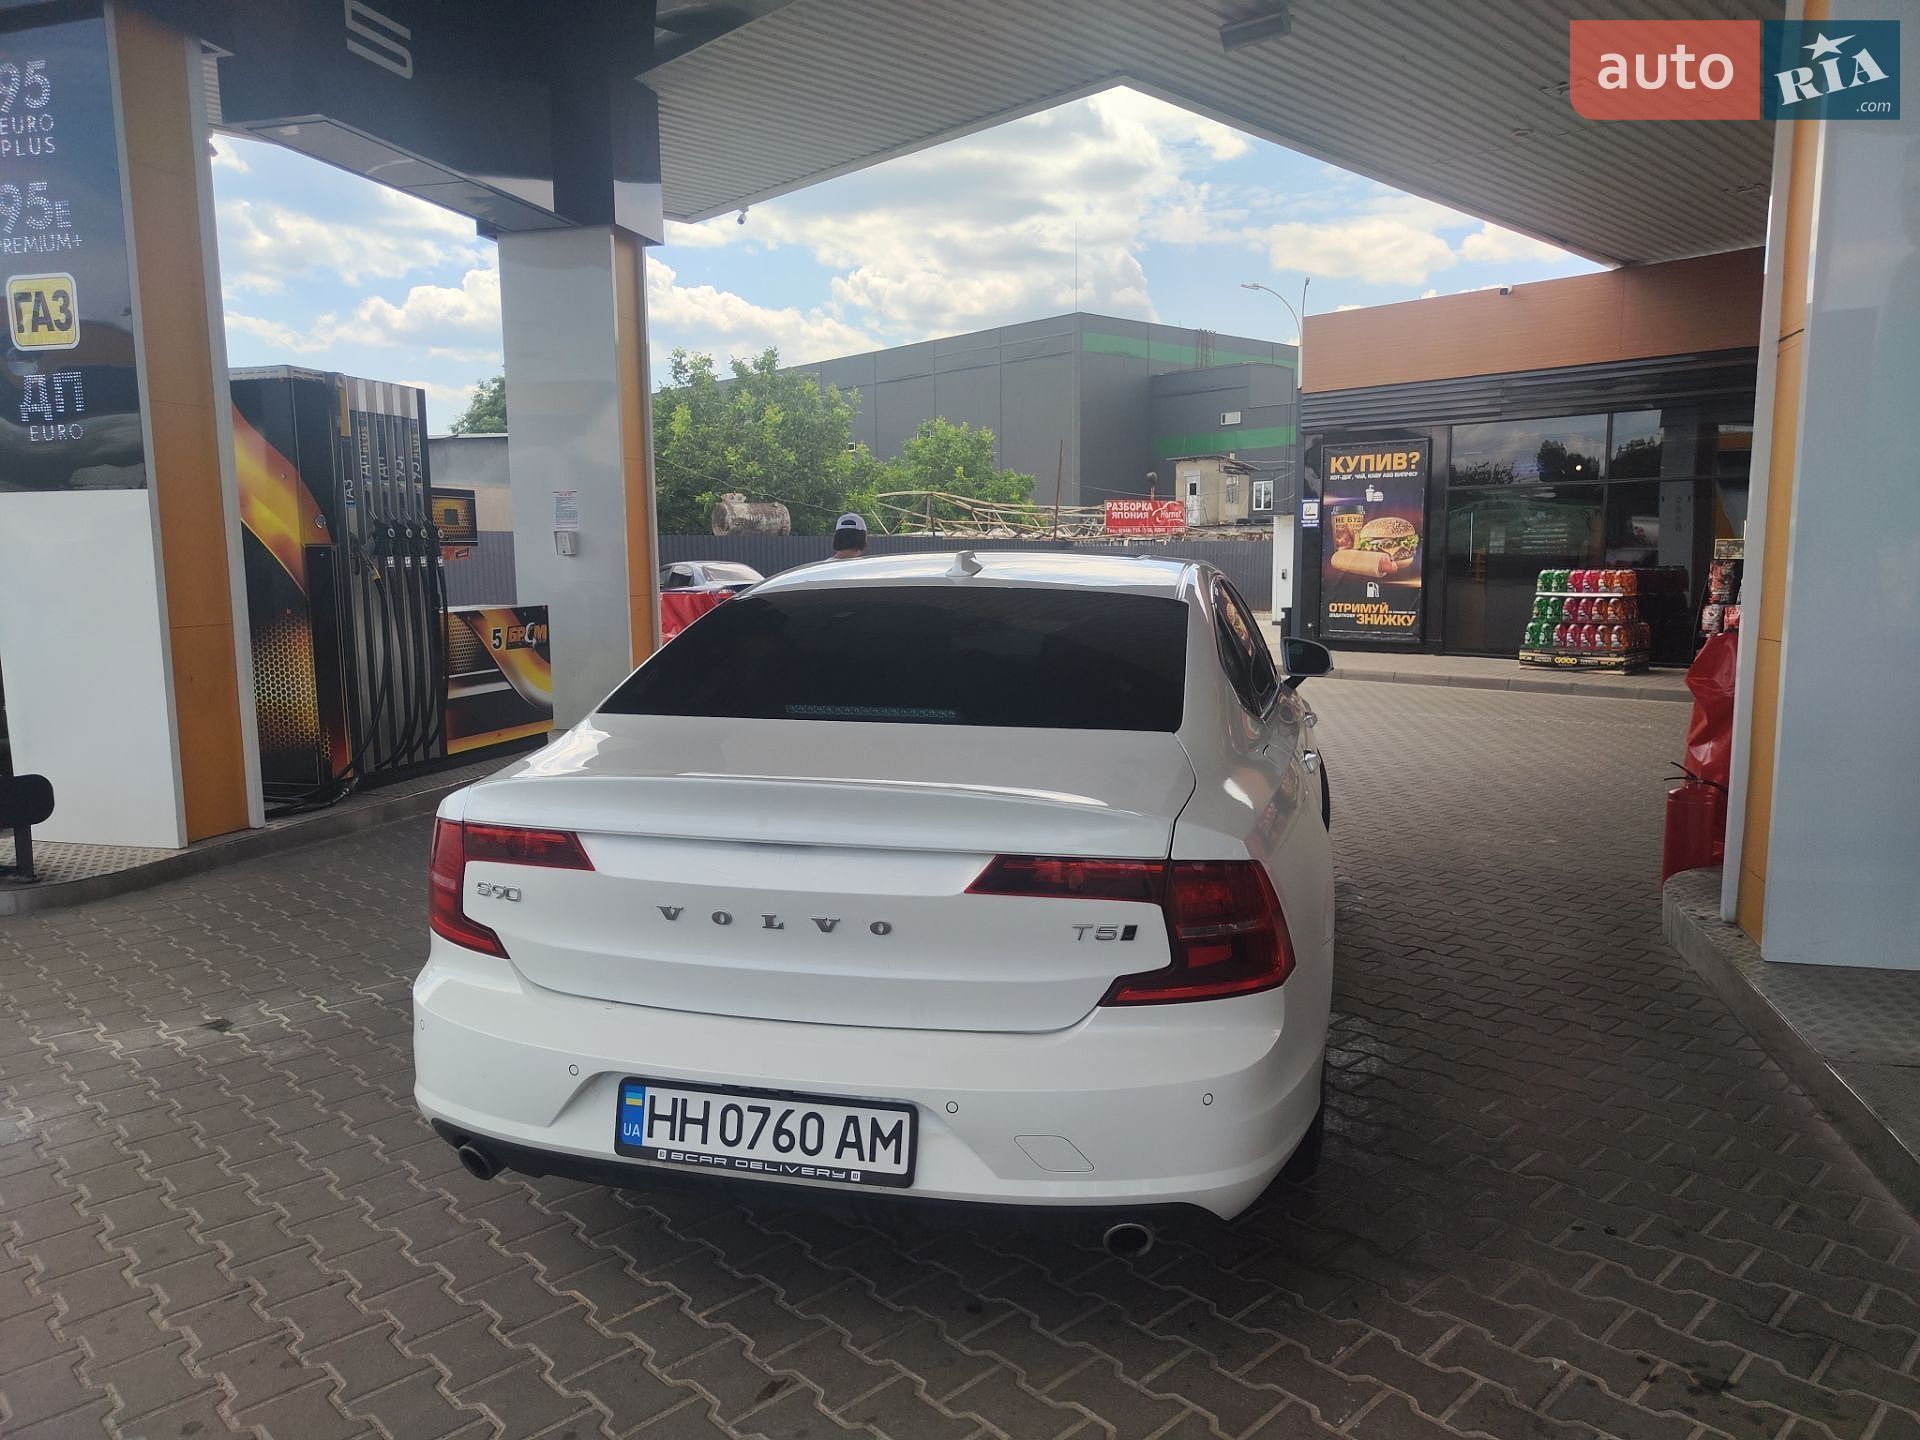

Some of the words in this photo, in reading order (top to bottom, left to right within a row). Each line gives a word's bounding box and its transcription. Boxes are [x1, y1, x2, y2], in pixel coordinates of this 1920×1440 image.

[0, 60, 50, 113] 95
[0, 114, 54, 135] EURO
[1, 136, 56, 157] PLUS
[0, 233, 83, 253] REMIUM+
[14, 289, 73, 333] ГАЗ
[19, 371, 84, 422] ДП
[29, 423, 85, 442] EURO
[1329, 451, 1421, 474] КУПИВ?
[1106, 502, 1153, 511] РАЗБОРКА
[1111, 511, 1149, 519] ЯПОНИЯ
[1328, 602, 1389, 614] ОТРИМУЙ
[1355, 613, 1417, 626] ЗНИЖКУ
[492, 627, 503, 650] 5
[1554, 656, 1578, 665] GOOD
[477, 881, 521, 902] S90
[656, 905, 893, 936] VOLVO
[1072, 923, 1119, 941] T5
[623, 1123, 641, 1138] UA
[671, 1152, 727, 1166] BCAR
[735, 1160, 846, 1179] DELIVERY
